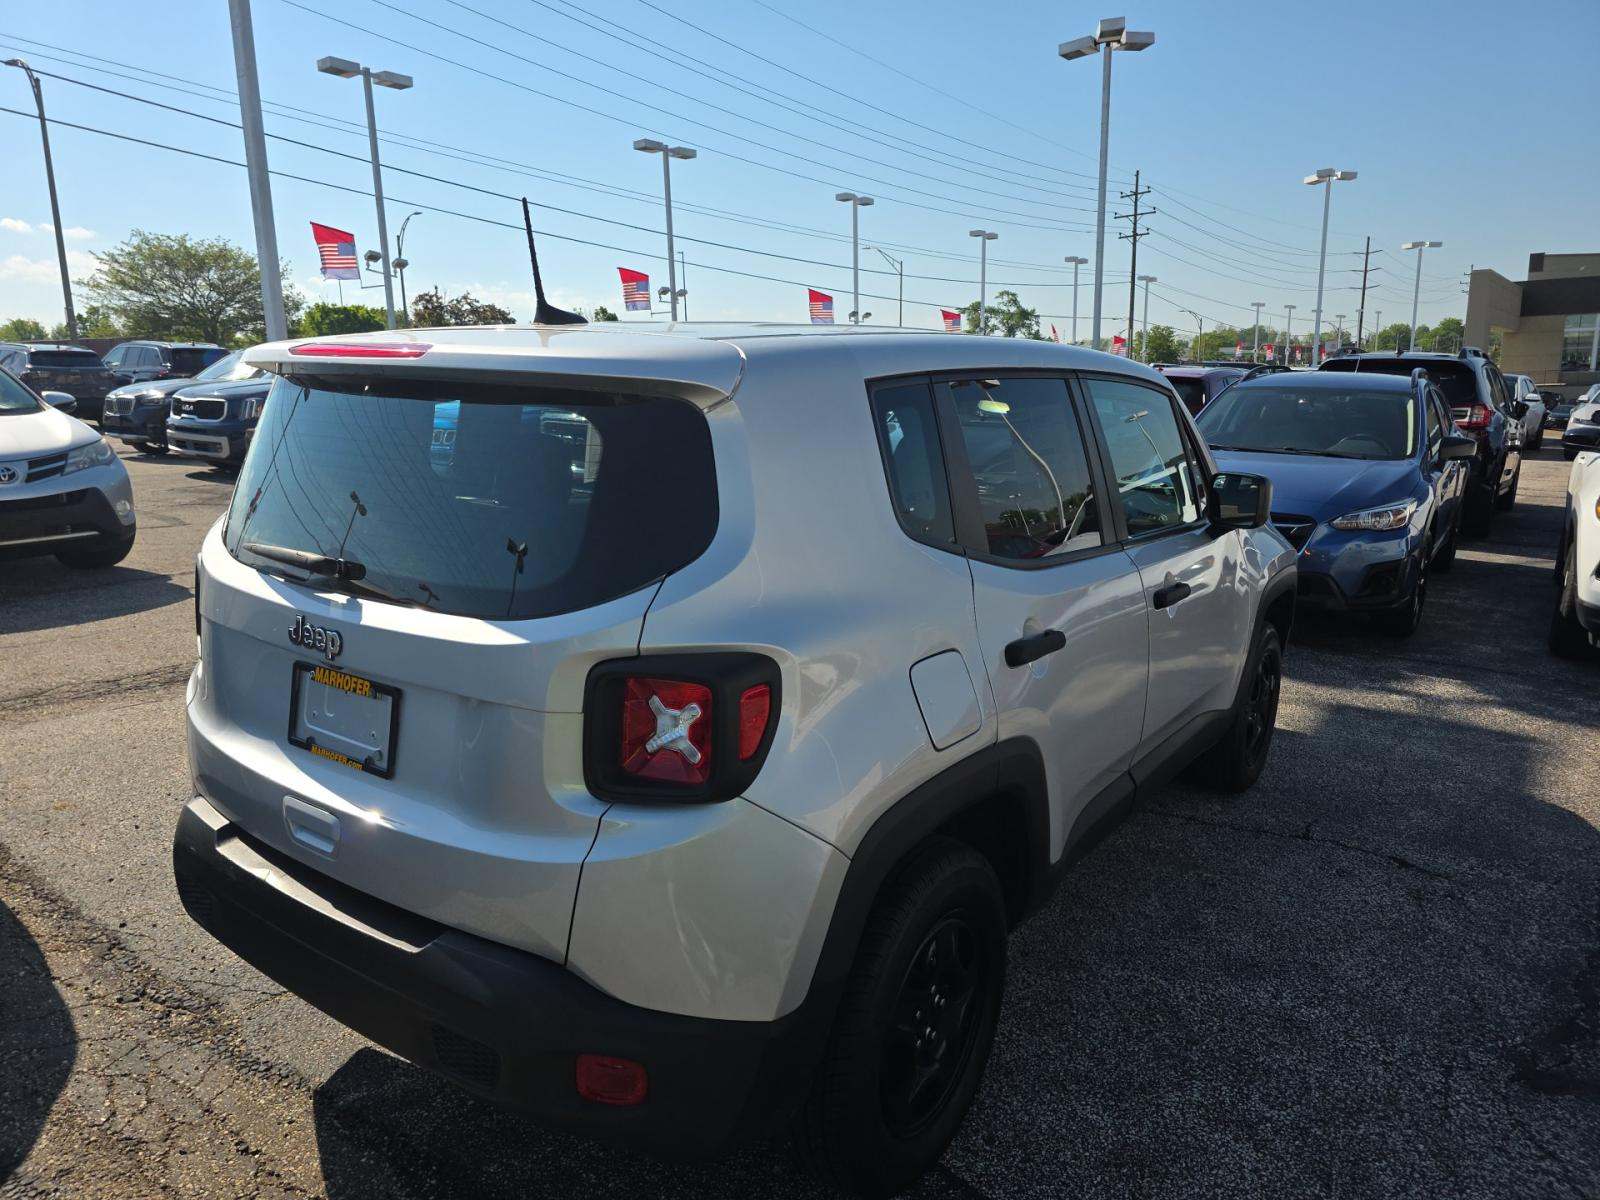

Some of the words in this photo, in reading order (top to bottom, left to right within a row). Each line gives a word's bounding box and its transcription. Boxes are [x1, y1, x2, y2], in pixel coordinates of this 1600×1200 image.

[288, 613, 343, 661] Jeep
[314, 666, 371, 696] MARHOFER
[311, 745, 363, 770] MARHOFER.com
